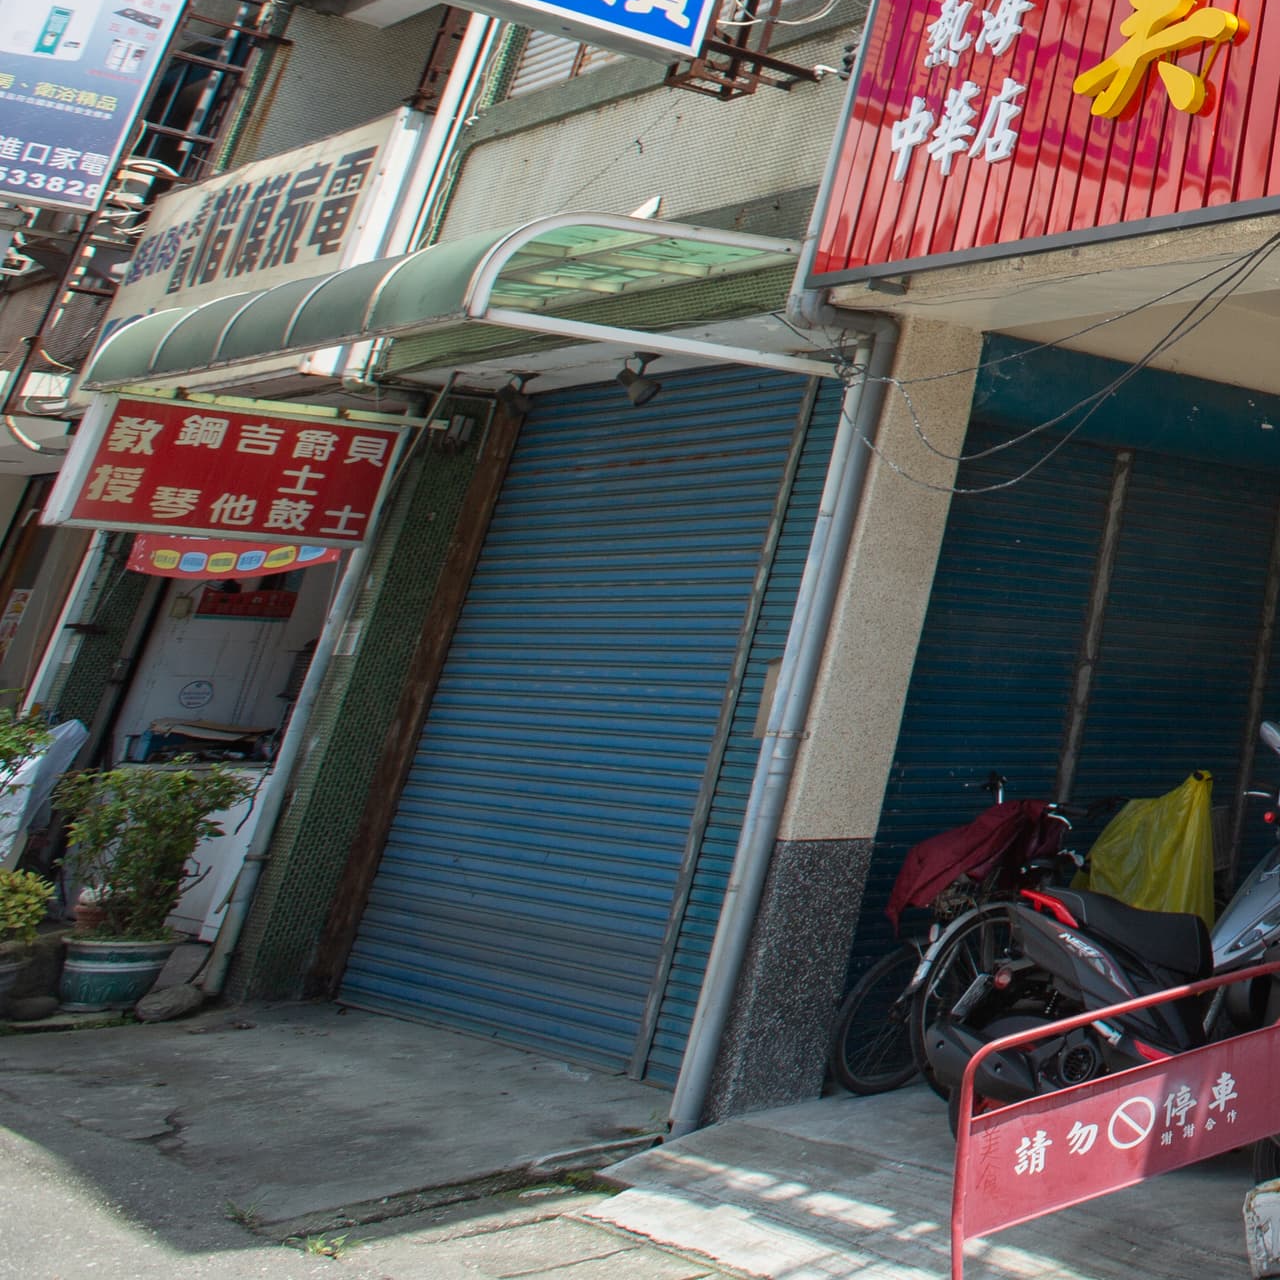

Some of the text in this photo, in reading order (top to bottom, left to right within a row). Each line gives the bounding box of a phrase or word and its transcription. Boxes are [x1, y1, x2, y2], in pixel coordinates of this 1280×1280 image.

[891, 77, 1027, 183] 中華店
[149, 414, 230, 519] 鋼琴
[210, 423, 285, 526] 吉他
